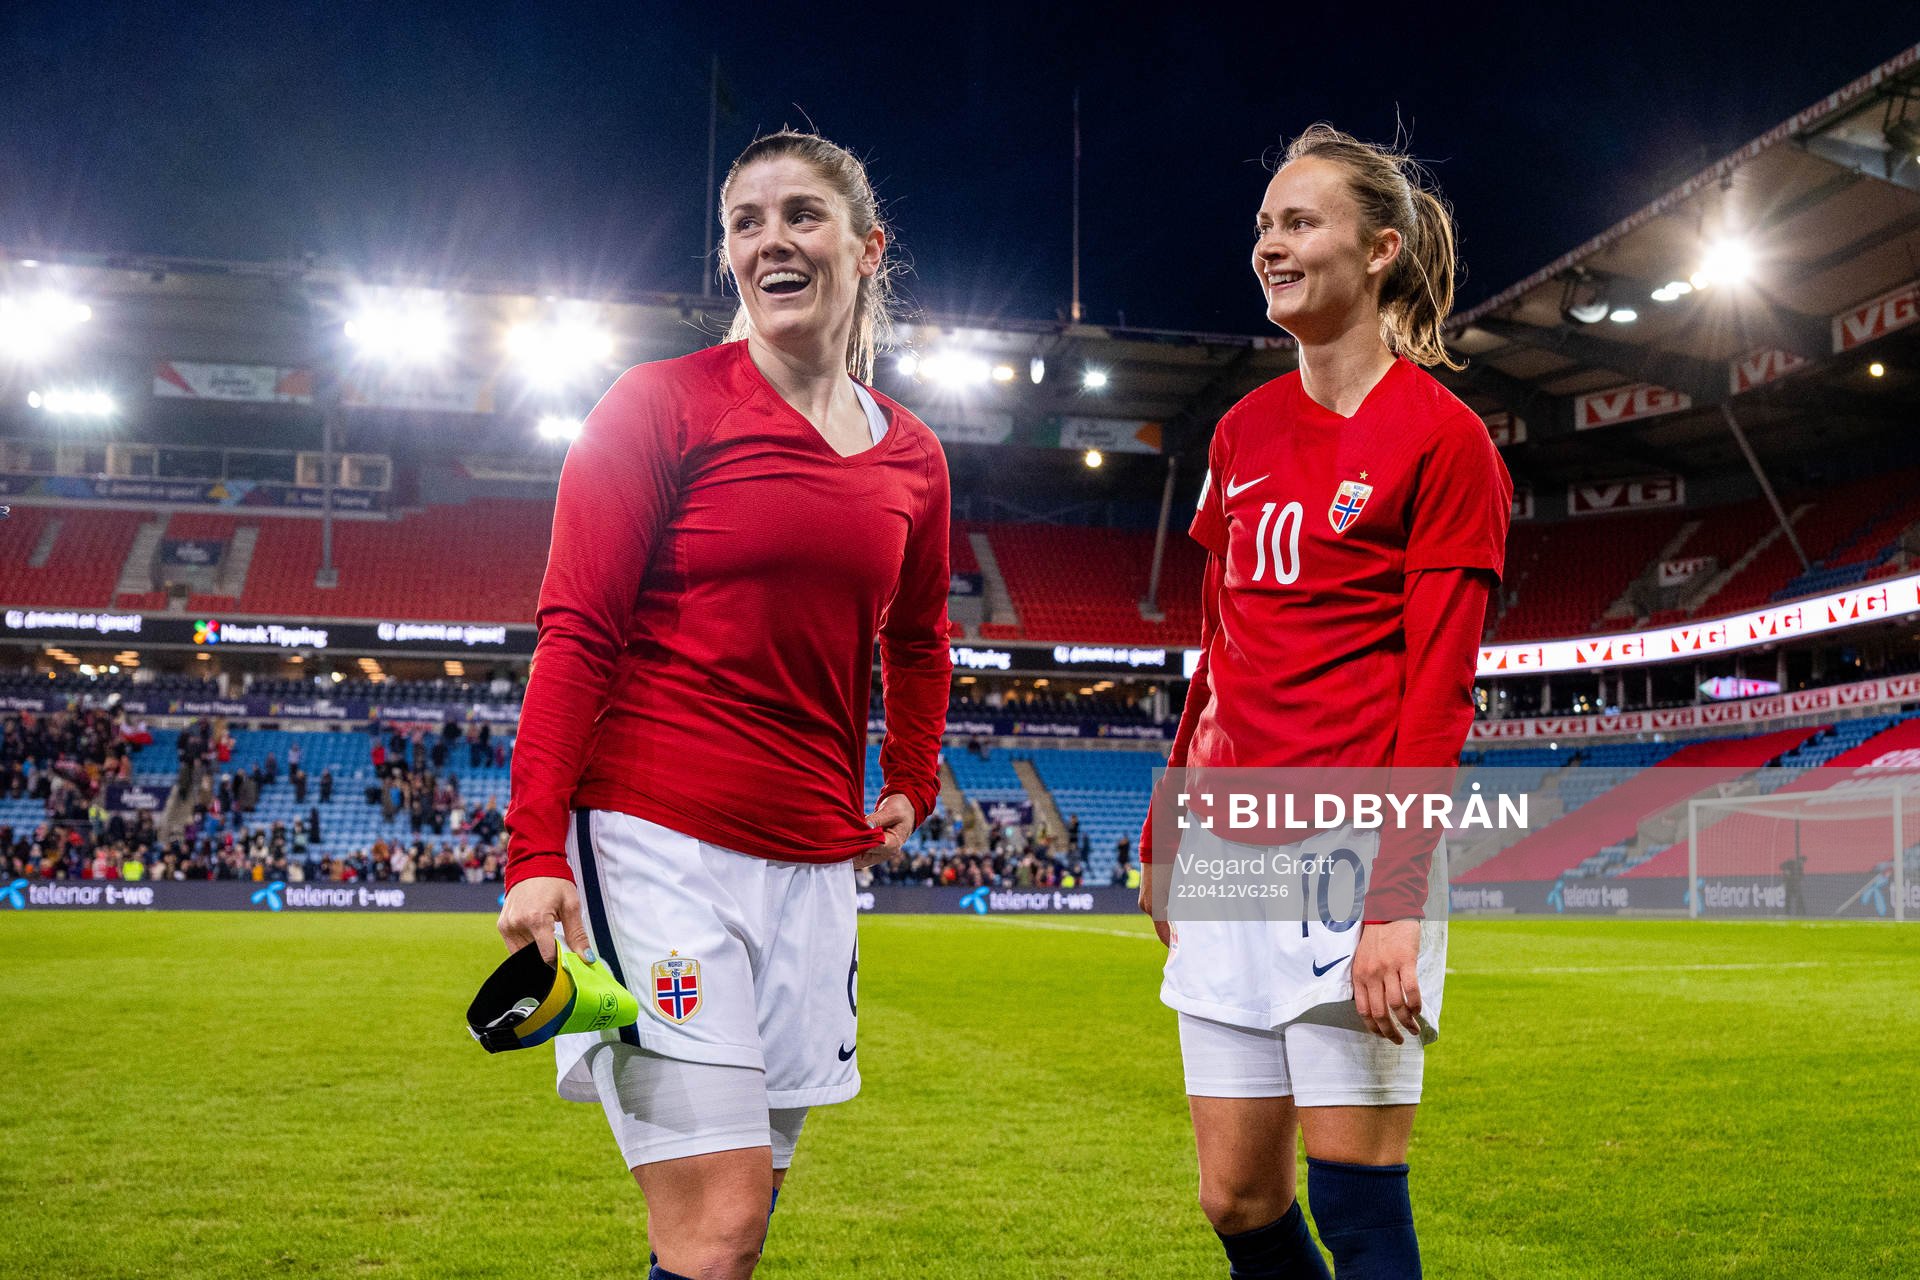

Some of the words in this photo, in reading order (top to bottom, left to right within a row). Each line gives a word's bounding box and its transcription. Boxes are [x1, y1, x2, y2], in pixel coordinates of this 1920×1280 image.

[1589, 382, 1677, 422] VG
[1577, 478, 1674, 511] VG
[1252, 501, 1304, 585] 10
[1828, 588, 1888, 624] VG
[1749, 607, 1802, 640] VG
[1576, 637, 1644, 665] VG
[1671, 625, 1727, 653] VG
[1473, 723, 1524, 737] VG
[1535, 718, 1587, 735] VG
[1596, 714, 1643, 732] VG
[29, 882, 103, 905] telenor
[105, 884, 154, 905] t-we
[286, 884, 355, 907] telenor
[358, 886, 405, 907] t-we
[990, 890, 1050, 910] telenor
[1053, 891, 1094, 910] t-we
[1301, 848, 1365, 938] 10
[1564, 884, 1600, 907] telenor
[1705, 881, 1750, 907] telenor
